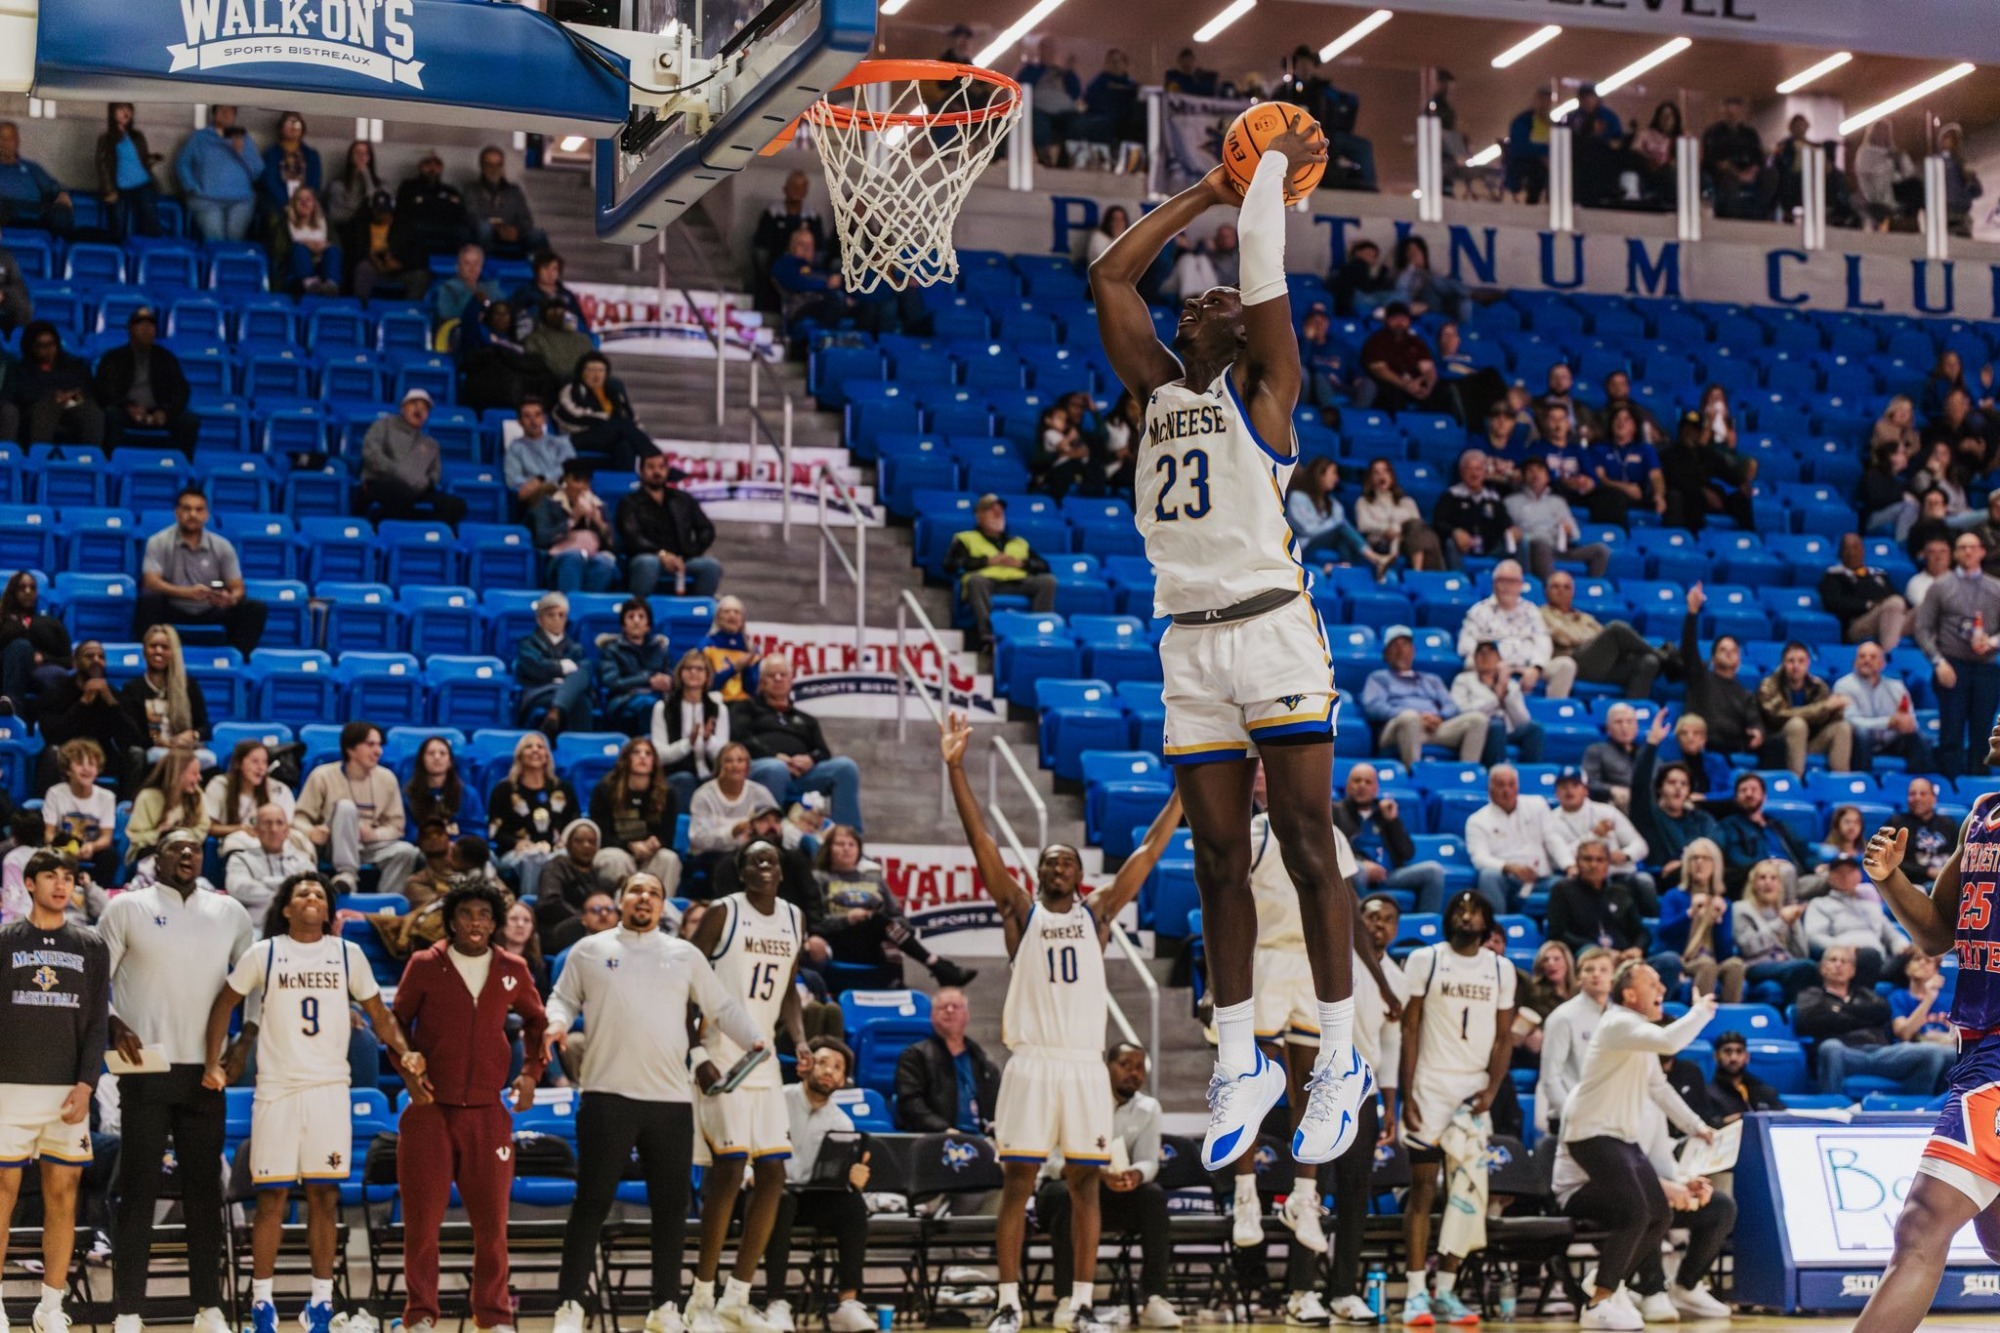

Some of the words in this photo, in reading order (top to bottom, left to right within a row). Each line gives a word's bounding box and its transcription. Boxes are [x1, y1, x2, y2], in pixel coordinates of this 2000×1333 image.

[223, 45, 283, 57] SPORTS
[288, 46, 371, 66] BISTREAUX
[1149, 406, 1227, 448] McNEESE
[1155, 449, 1212, 521] 23
[1958, 882, 1995, 930] 25
[744, 935, 791, 957] McNEESE
[1048, 946, 1078, 983] 10
[278, 972, 340, 989] McNEESE
[749, 962, 778, 1001] 15
[1441, 982, 1491, 1001] McNEESE
[301, 996, 320, 1037] 9
[1462, 1006, 1468, 1040] 1
